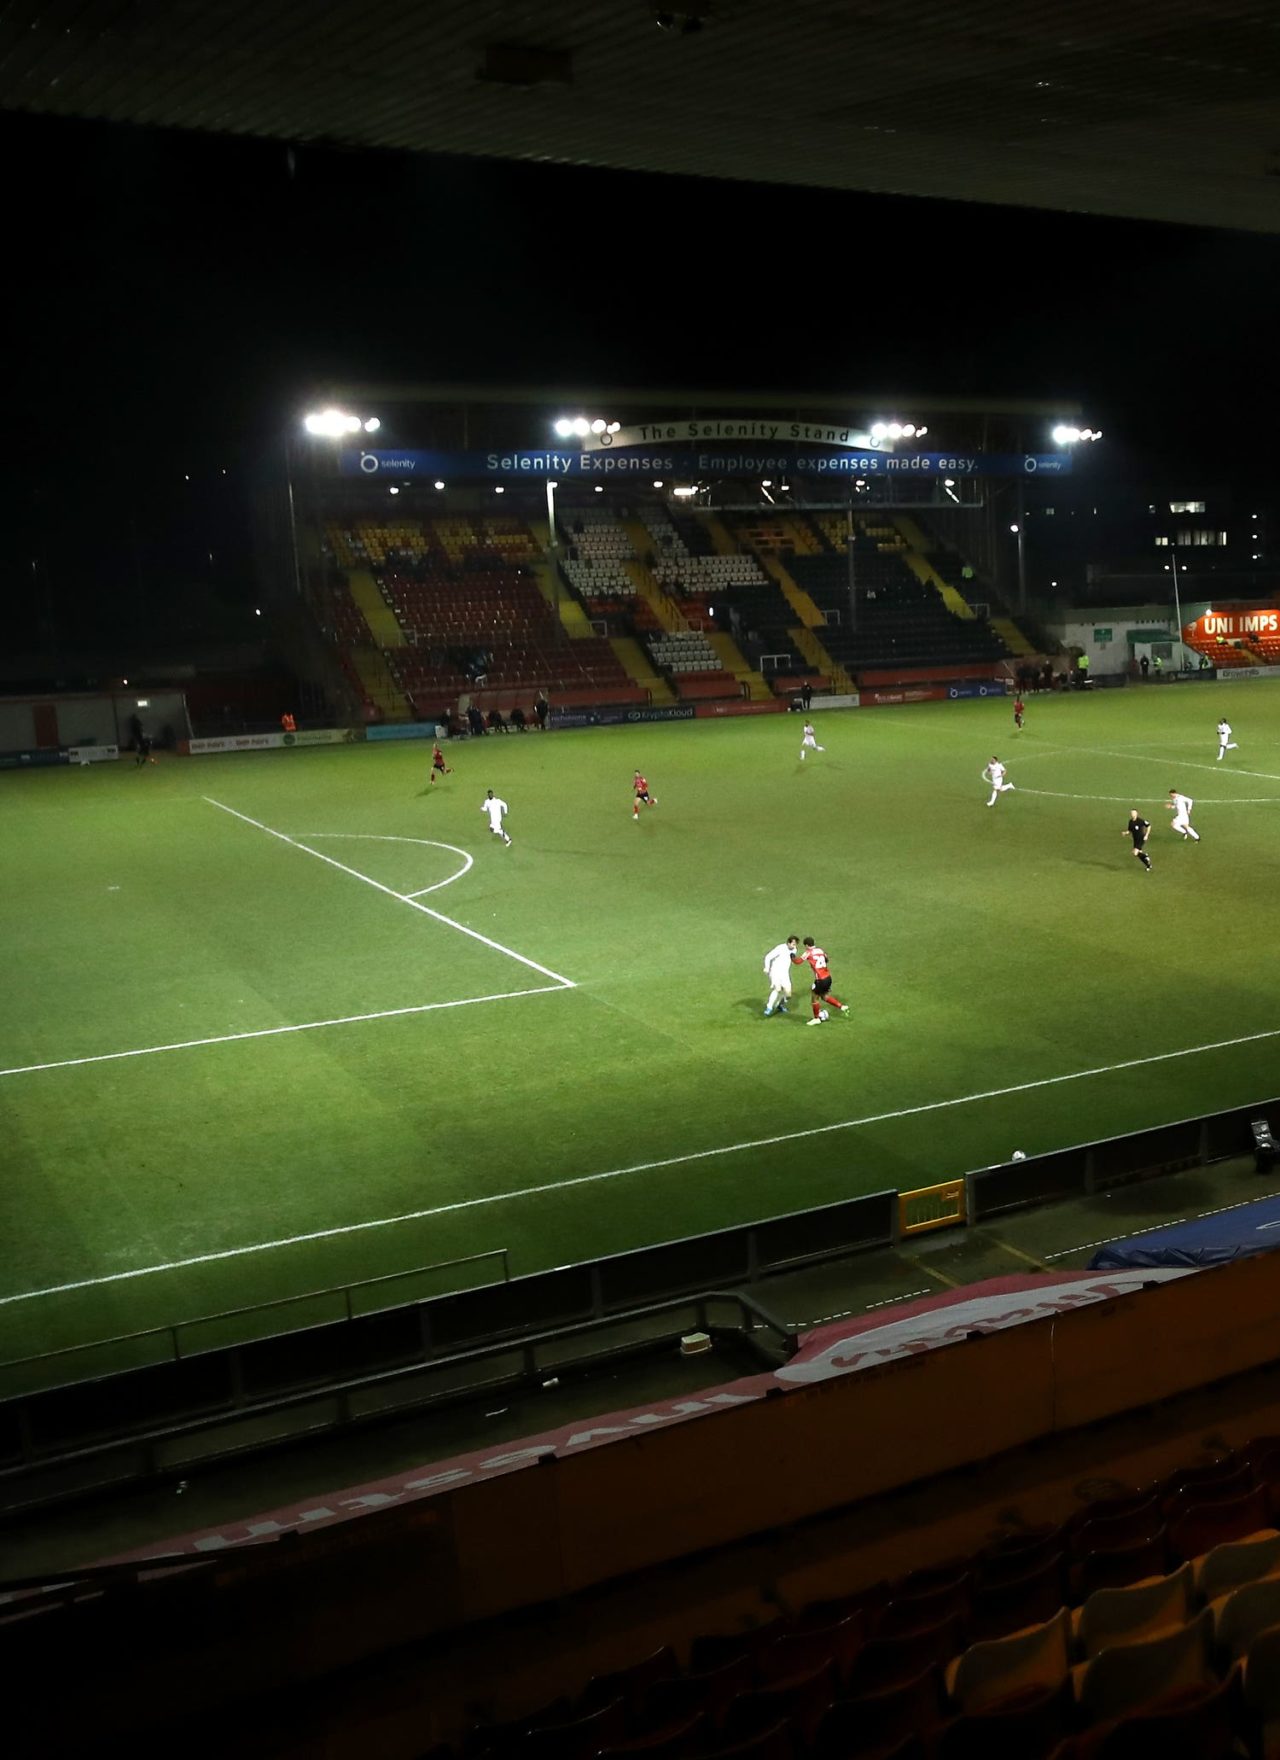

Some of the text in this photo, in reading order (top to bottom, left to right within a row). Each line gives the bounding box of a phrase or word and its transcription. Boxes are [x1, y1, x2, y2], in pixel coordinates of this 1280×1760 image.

[640, 423, 850, 443] The Selenity Stand
[381, 457, 416, 471] selenity
[487, 453, 979, 475] Selenity Expenses Employee expenses made easy.
[1203, 614, 1234, 635] UNI
[1239, 614, 1278, 632] IMPS
[641, 707, 693, 722] KryptoKloud
